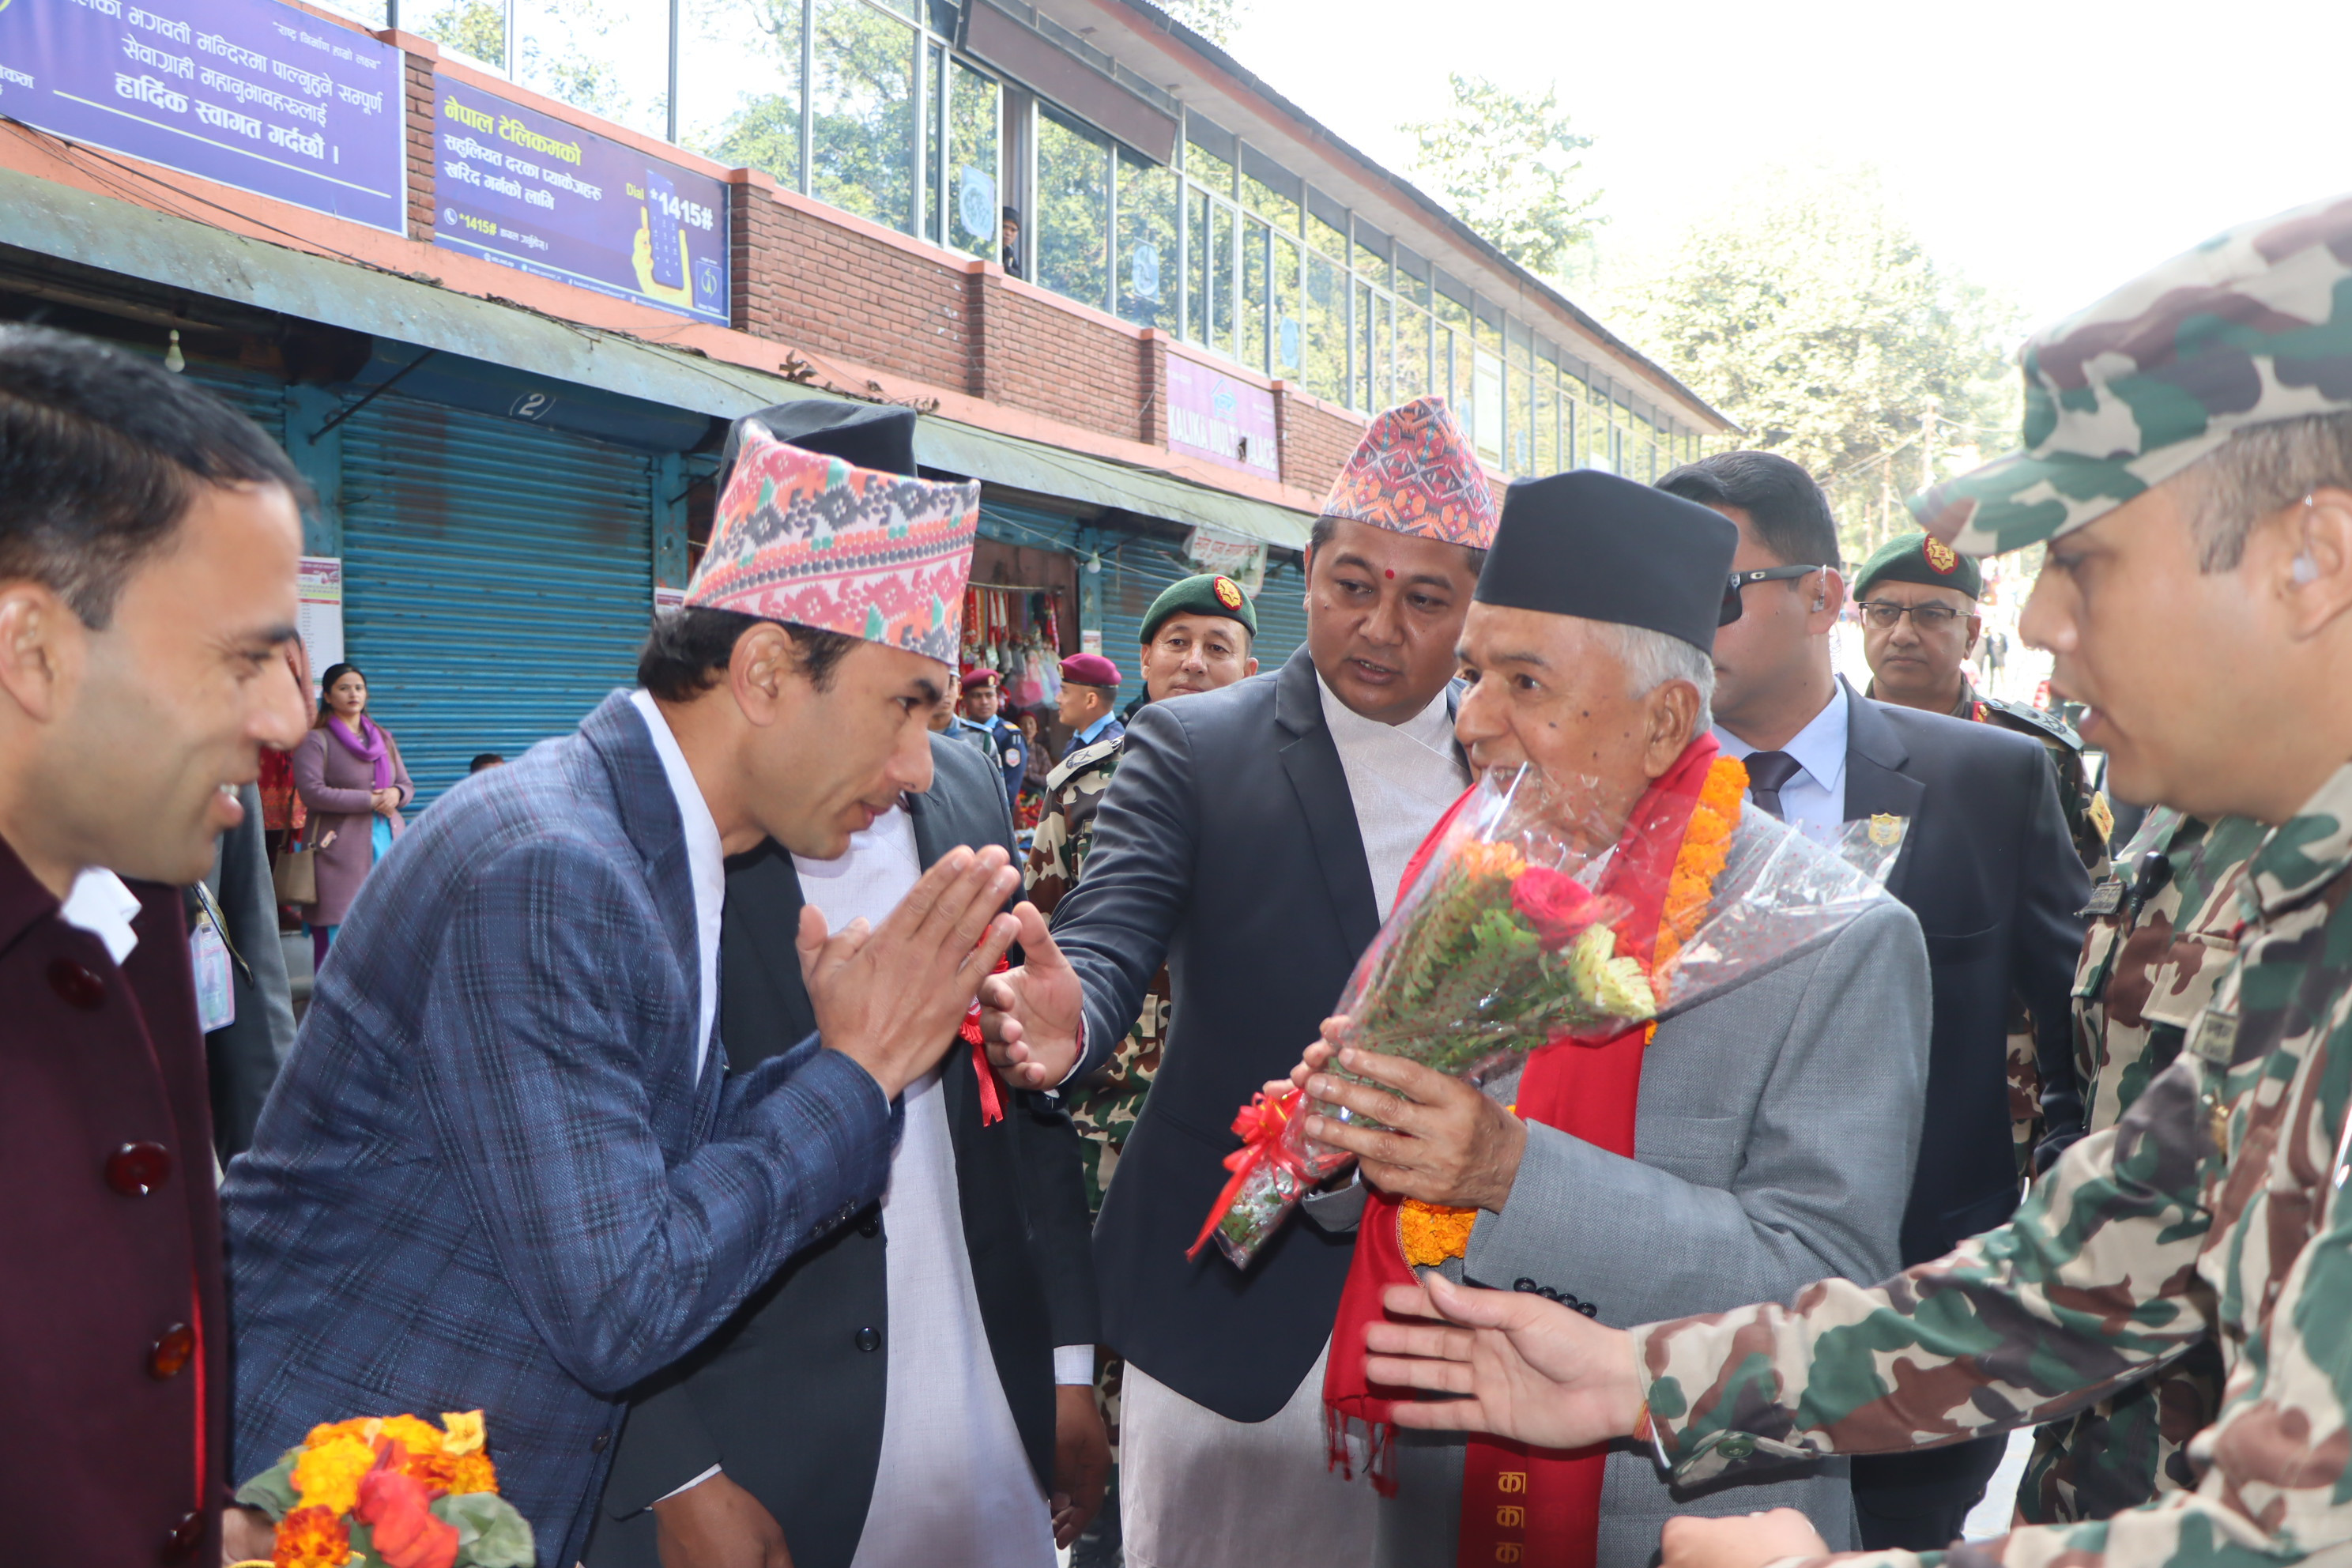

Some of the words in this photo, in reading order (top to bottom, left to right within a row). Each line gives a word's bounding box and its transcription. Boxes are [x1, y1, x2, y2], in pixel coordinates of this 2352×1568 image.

[121, 32, 195, 80] सेवाग्राही
[128, 6, 192, 45] भगवती
[195, 31, 269, 74] मन्दिरमा
[271, 59, 334, 99] पाल्नुहुने
[337, 83, 384, 116] सम्पूर्ण
[115, 72, 190, 114] हार्दिक
[194, 99, 262, 140] स्वागत
[443, 95, 496, 135] नेपाल
[498, 115, 582, 167] टेलिकमको
[443, 134, 503, 167] सहुलियत
[505, 155, 541, 180] दरका
[443, 160, 481, 187] खरिद
[484, 174, 523, 200] गर्नको
[524, 187, 556, 210] लागि
[626, 183, 645, 201] Dial
[1240, 429, 1278, 473] ALACE
